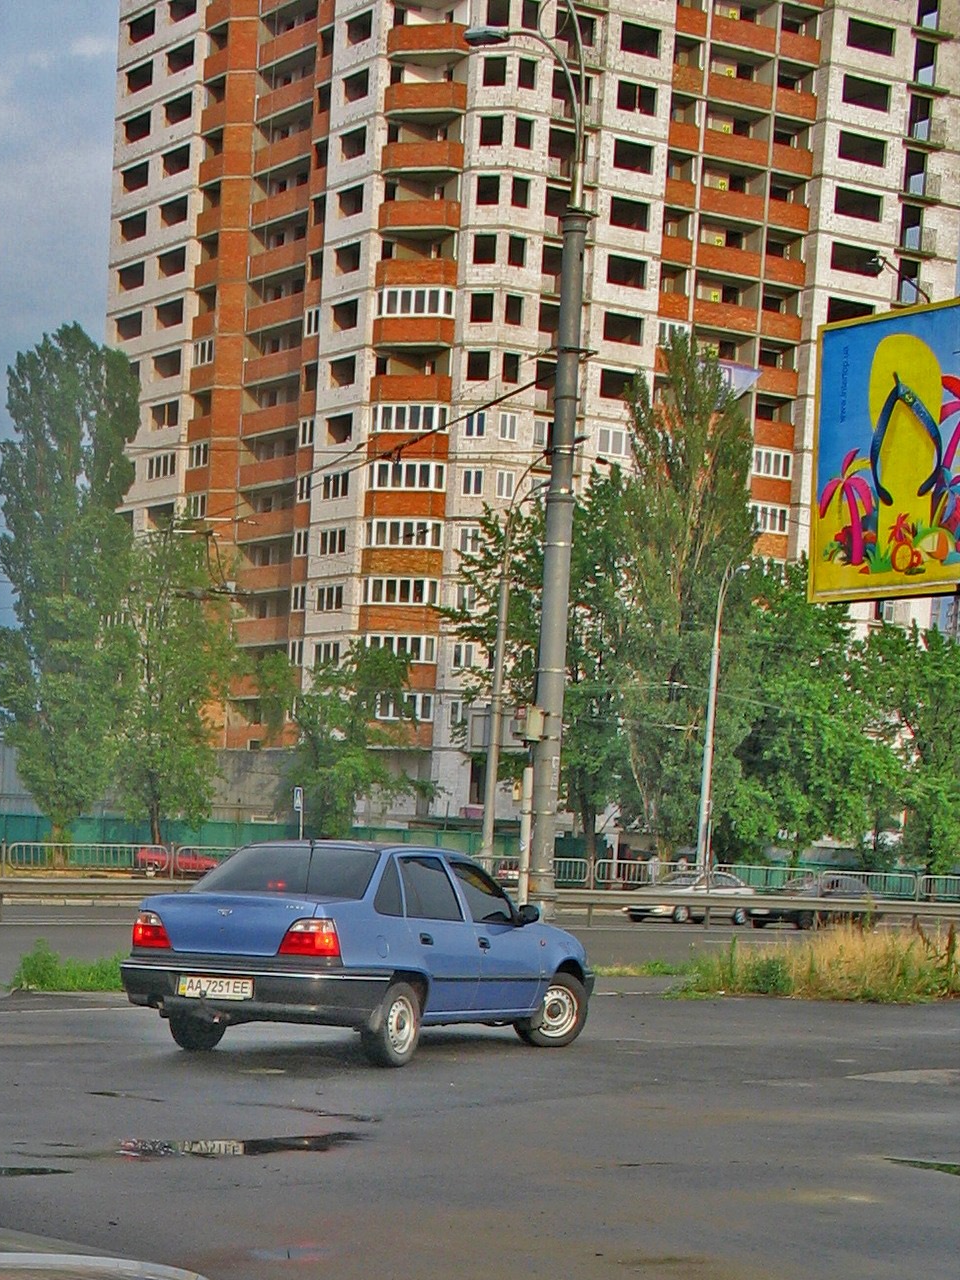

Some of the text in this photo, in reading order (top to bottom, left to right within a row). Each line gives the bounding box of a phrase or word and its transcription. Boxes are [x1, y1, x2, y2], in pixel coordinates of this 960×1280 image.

[186, 978, 250, 994] AA 7251 EE
